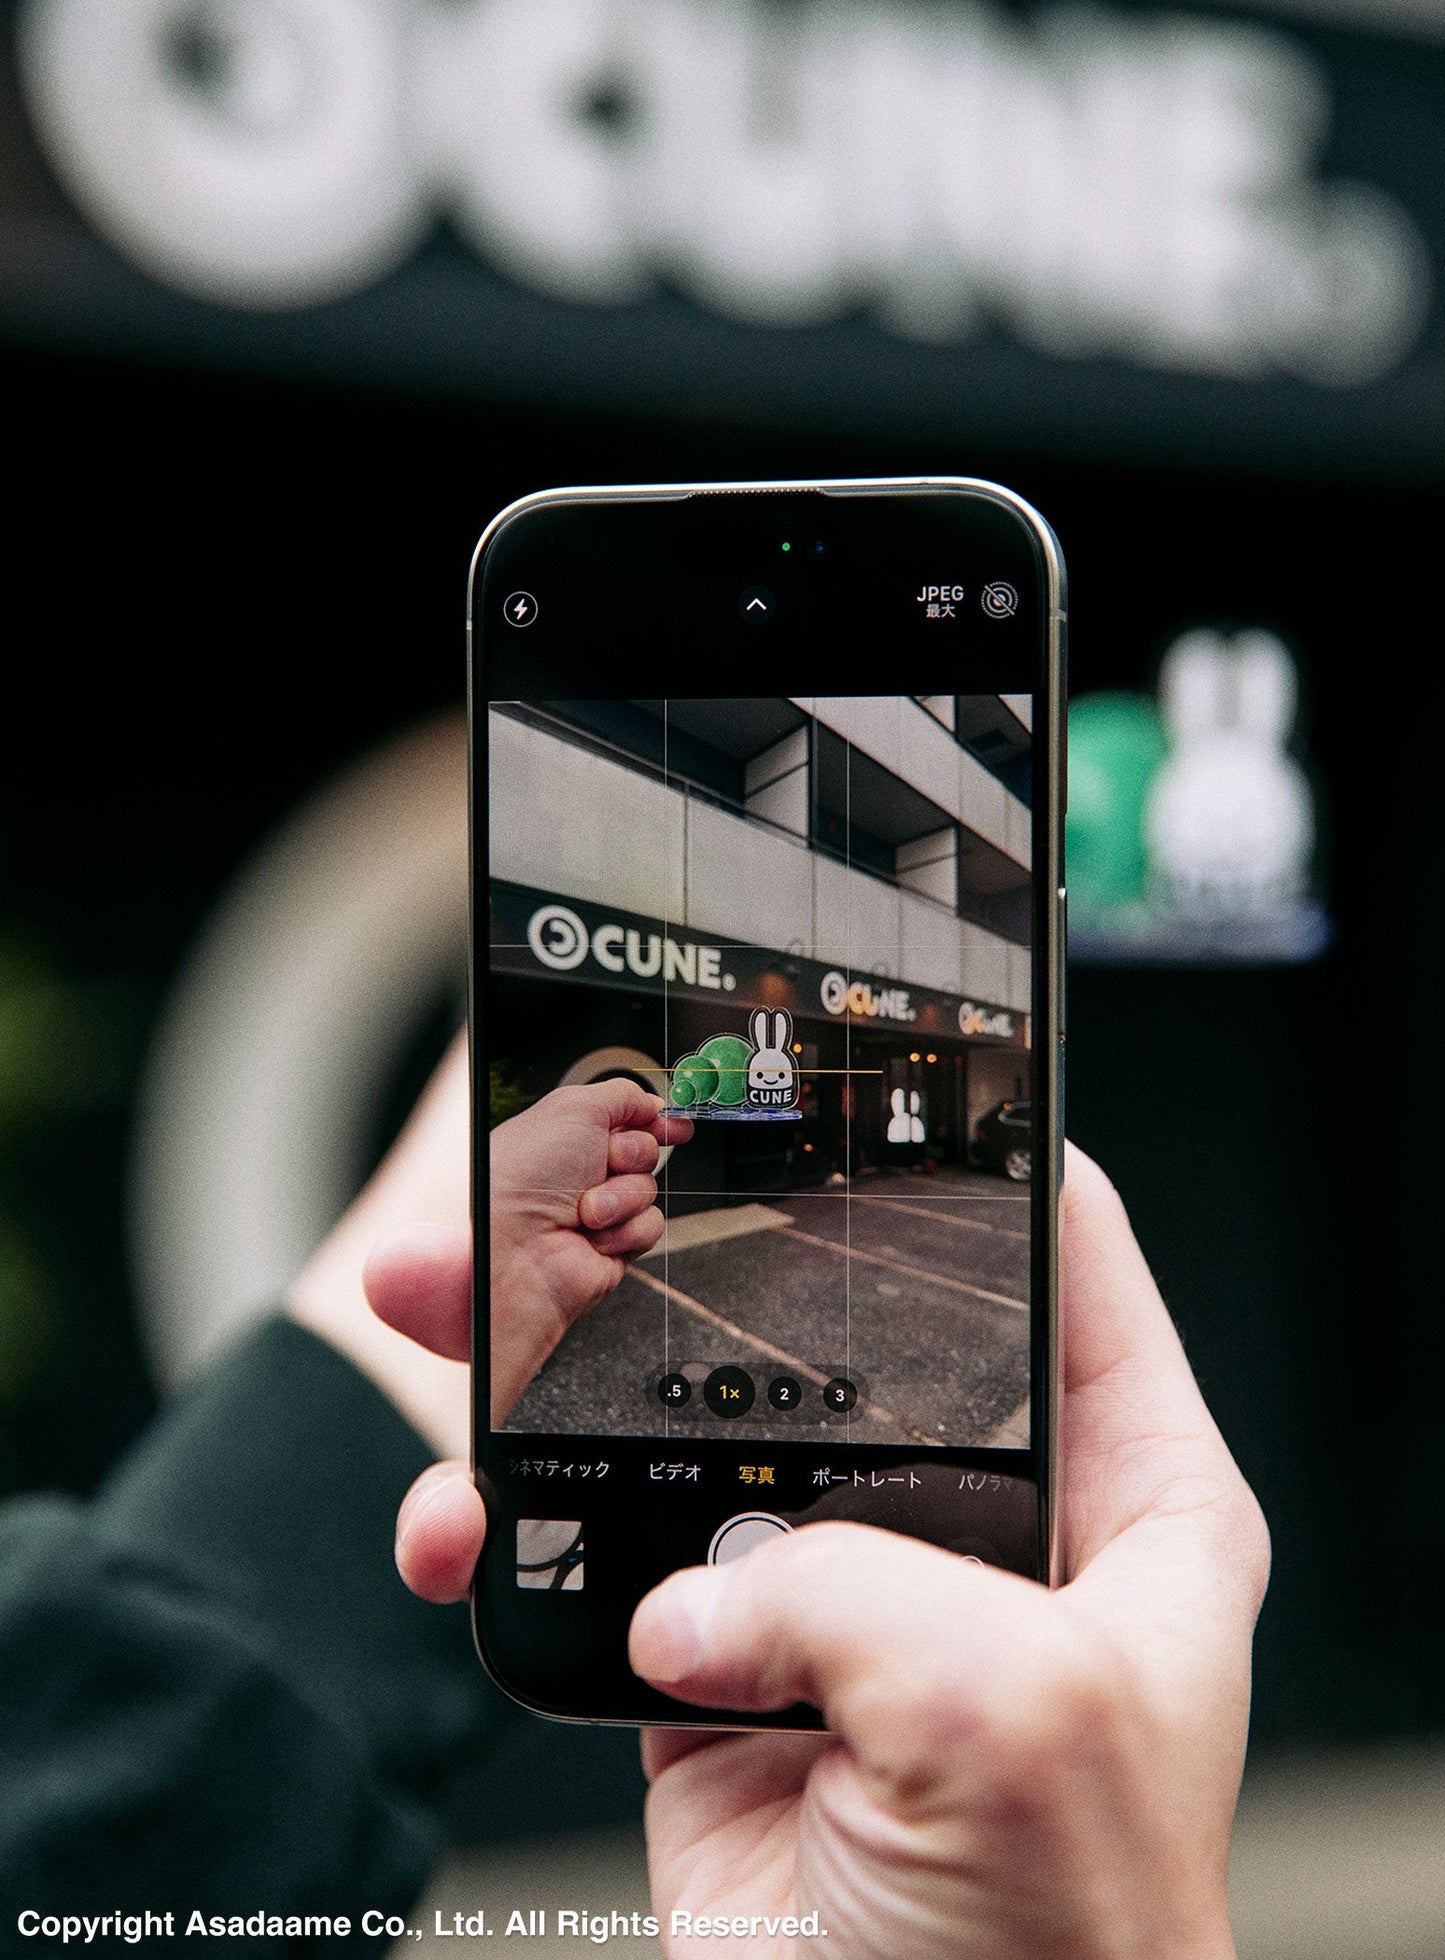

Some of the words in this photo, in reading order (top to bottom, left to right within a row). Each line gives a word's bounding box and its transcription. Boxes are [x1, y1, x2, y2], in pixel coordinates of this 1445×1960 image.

[916, 585, 964, 602] JPEG
[926, 603, 956, 618] 最大
[749, 1088, 793, 1104] CUNE
[667, 1384, 682, 1398] .5
[779, 1388, 789, 1400] 2
[835, 1389, 845, 1402] 3
[649, 1462, 702, 1482] ビデオ
[738, 1465, 776, 1486] 写真
[812, 1466, 922, 1490] ポートレート
